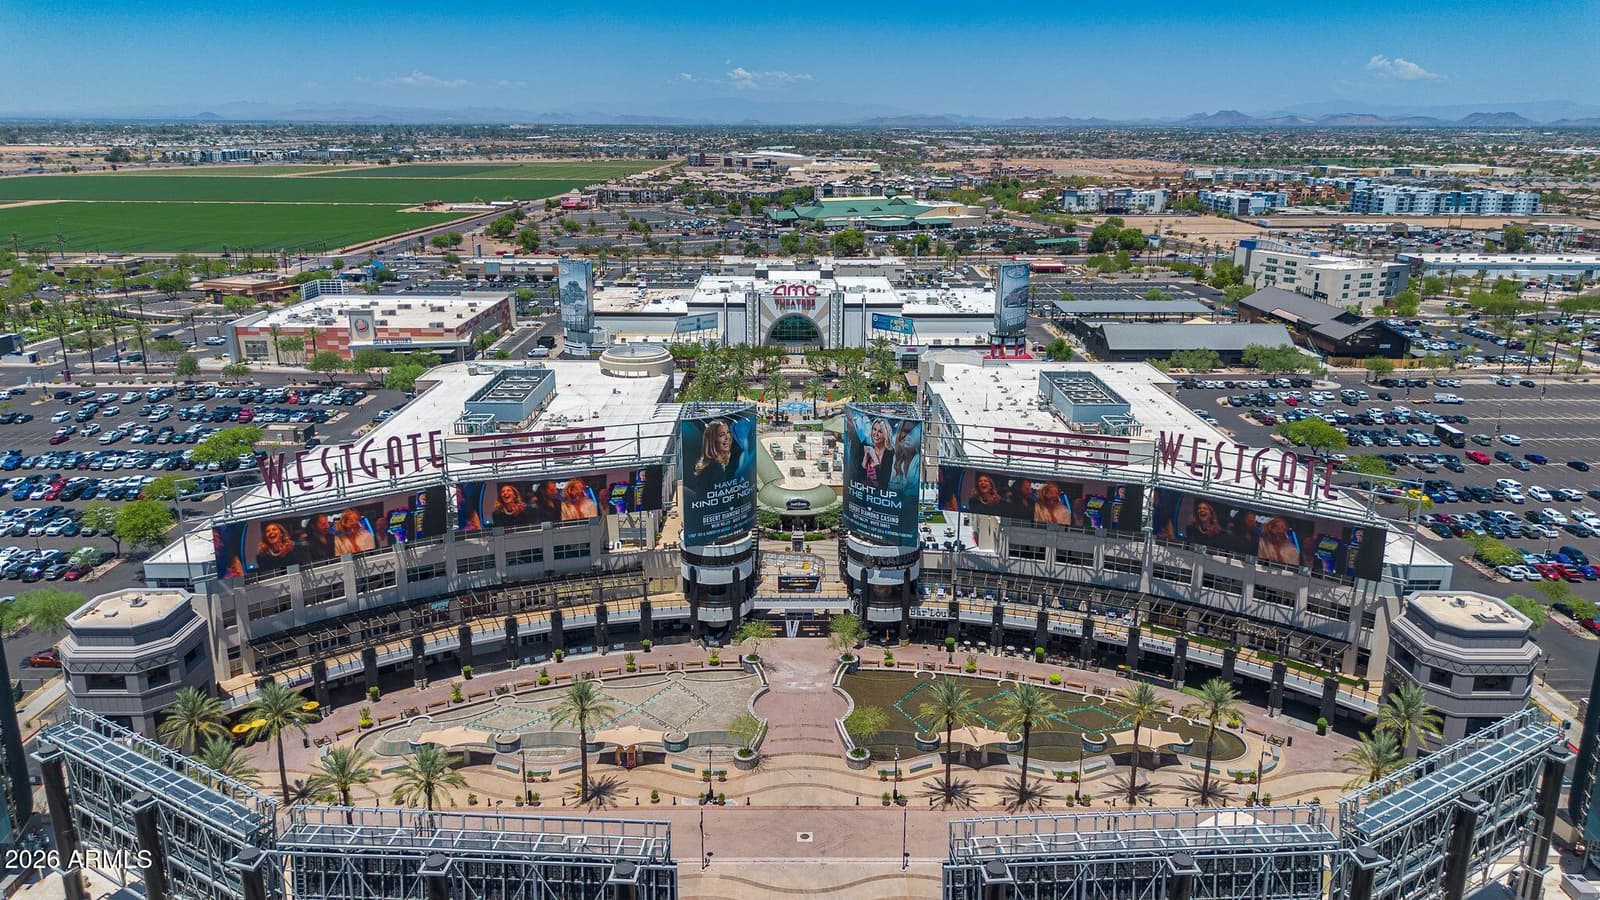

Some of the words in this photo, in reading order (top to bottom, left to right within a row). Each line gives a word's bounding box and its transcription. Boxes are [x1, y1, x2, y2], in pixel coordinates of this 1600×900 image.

[774, 298, 816, 310] THEATRES
[256, 430, 445, 497] WESTGATE
[1159, 430, 1343, 501] WESTGATE
[707, 481, 750, 498] DIAMOND
[714, 479, 738, 489] HAVE
[850, 480, 876, 494] LIGHT
[880, 490, 897, 498] UP
[691, 499, 718, 509] KIND
[722, 495, 735, 504] OF
[848, 486, 863, 500] THE
[866, 495, 902, 509] ROOM
[703, 515, 720, 524] DESERT
[880, 515, 899, 524] CASINO
